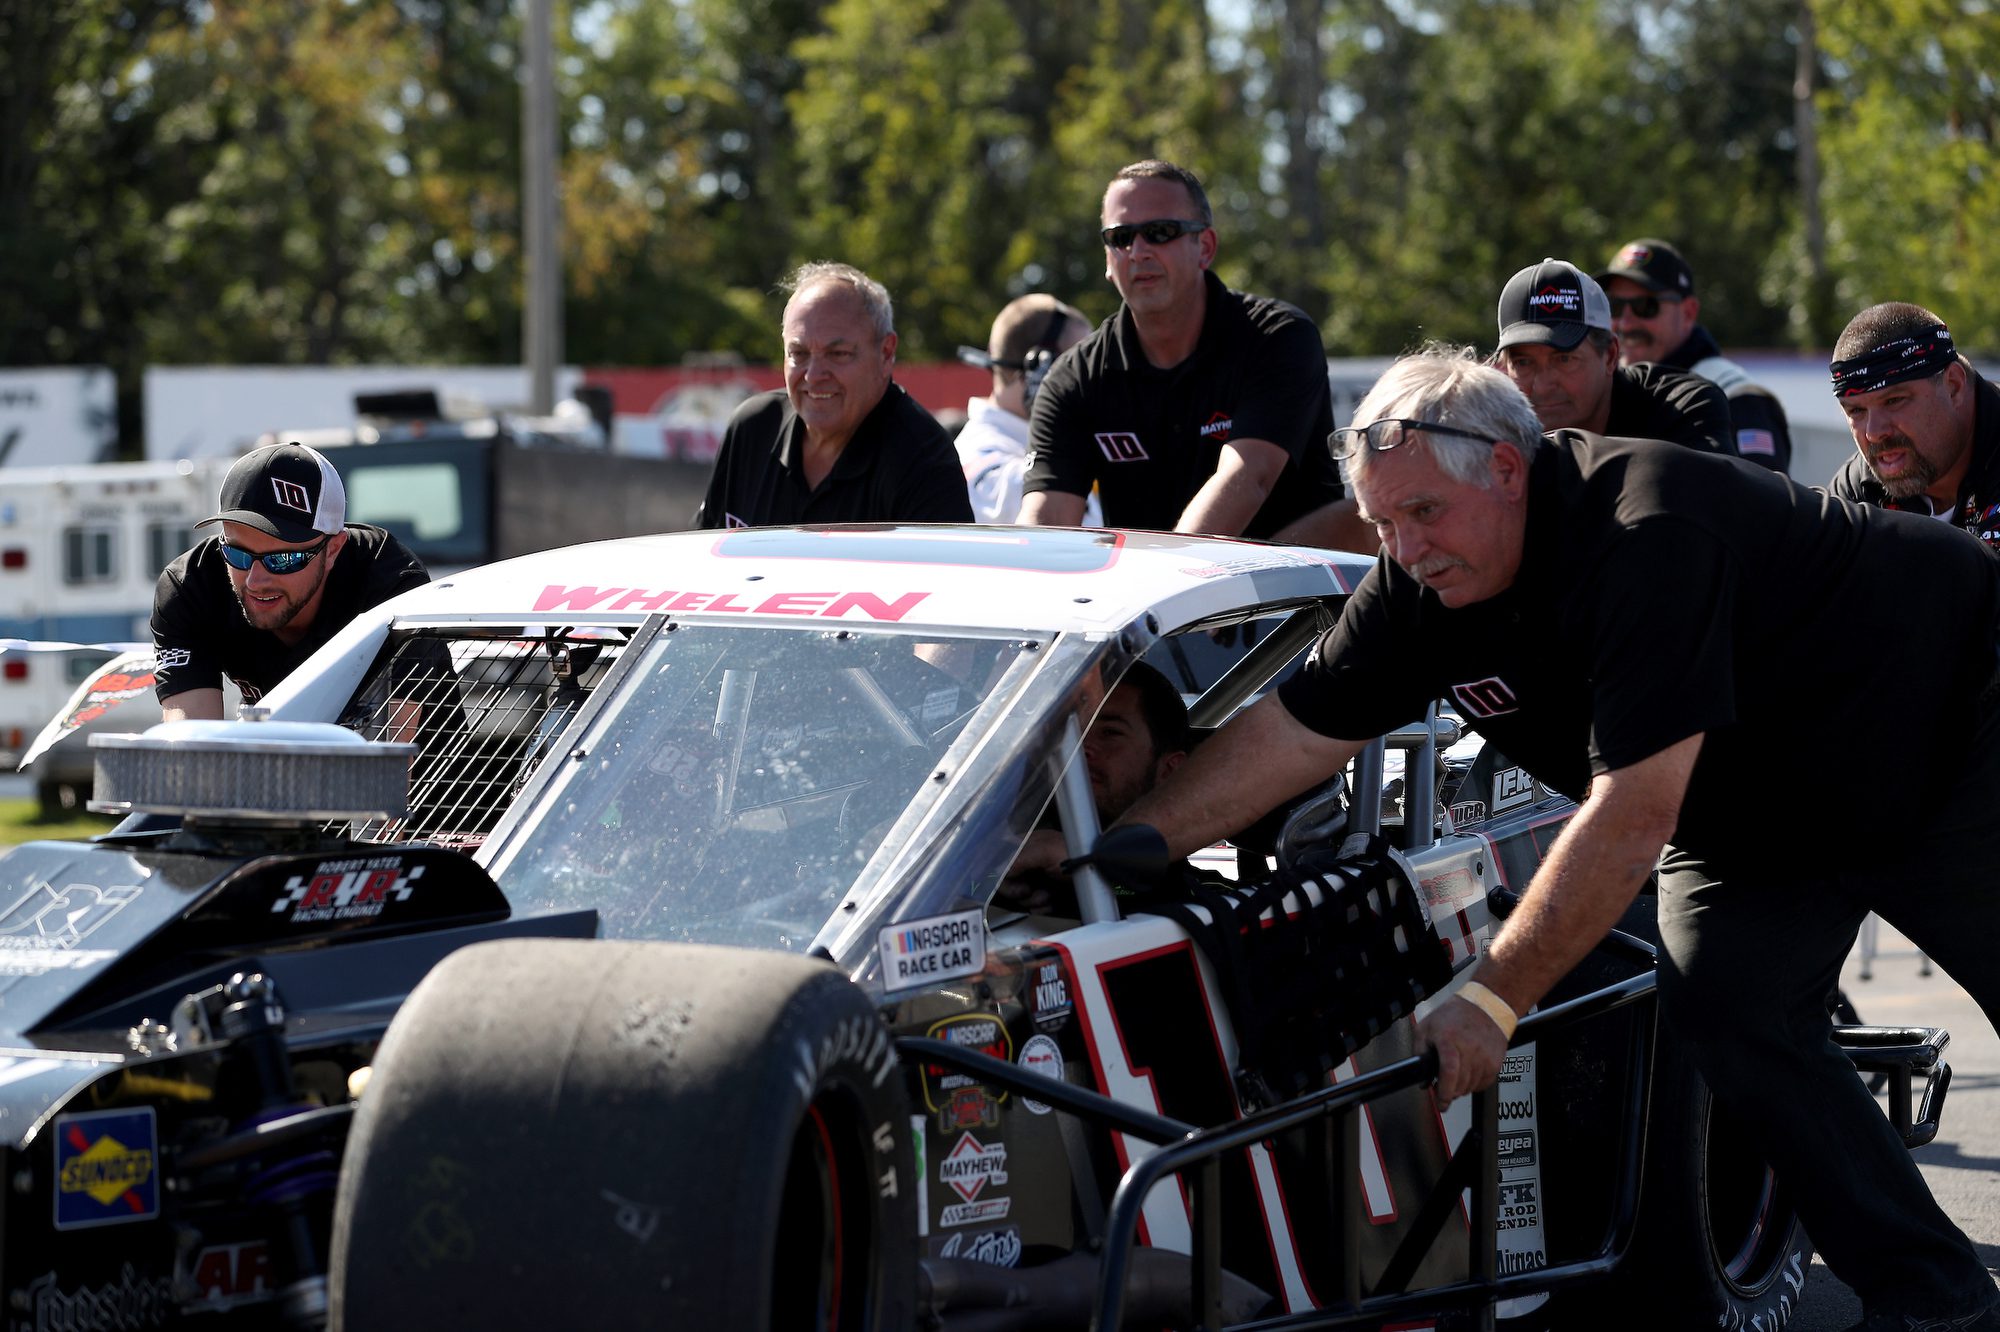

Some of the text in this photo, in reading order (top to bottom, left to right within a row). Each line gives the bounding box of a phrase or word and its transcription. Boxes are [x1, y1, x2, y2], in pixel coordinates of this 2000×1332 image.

[1530, 294, 1574, 305] MAYHEW
[1094, 432, 1149, 462] 10
[270, 477, 312, 514] 10
[531, 584, 932, 623] WHELEN
[1451, 676, 1519, 718] 10
[316, 856, 402, 874] ROBERT YATES
[299, 869, 401, 910] RYR
[290, 902, 385, 922] RACING ENGINES
[912, 920, 971, 951] NASCAR
[898, 948, 972, 979] RACE CAR
[1040, 963, 1058, 984] DON
[1036, 979, 1067, 1012] KING
[951, 1022, 996, 1046] NASCAR
[61, 1151, 152, 1190] SUNOCO
[943, 1156, 1004, 1178] MAYHEW
[1496, 1216, 1538, 1230] ENDS
[1504, 1204, 1536, 1217] ROD
